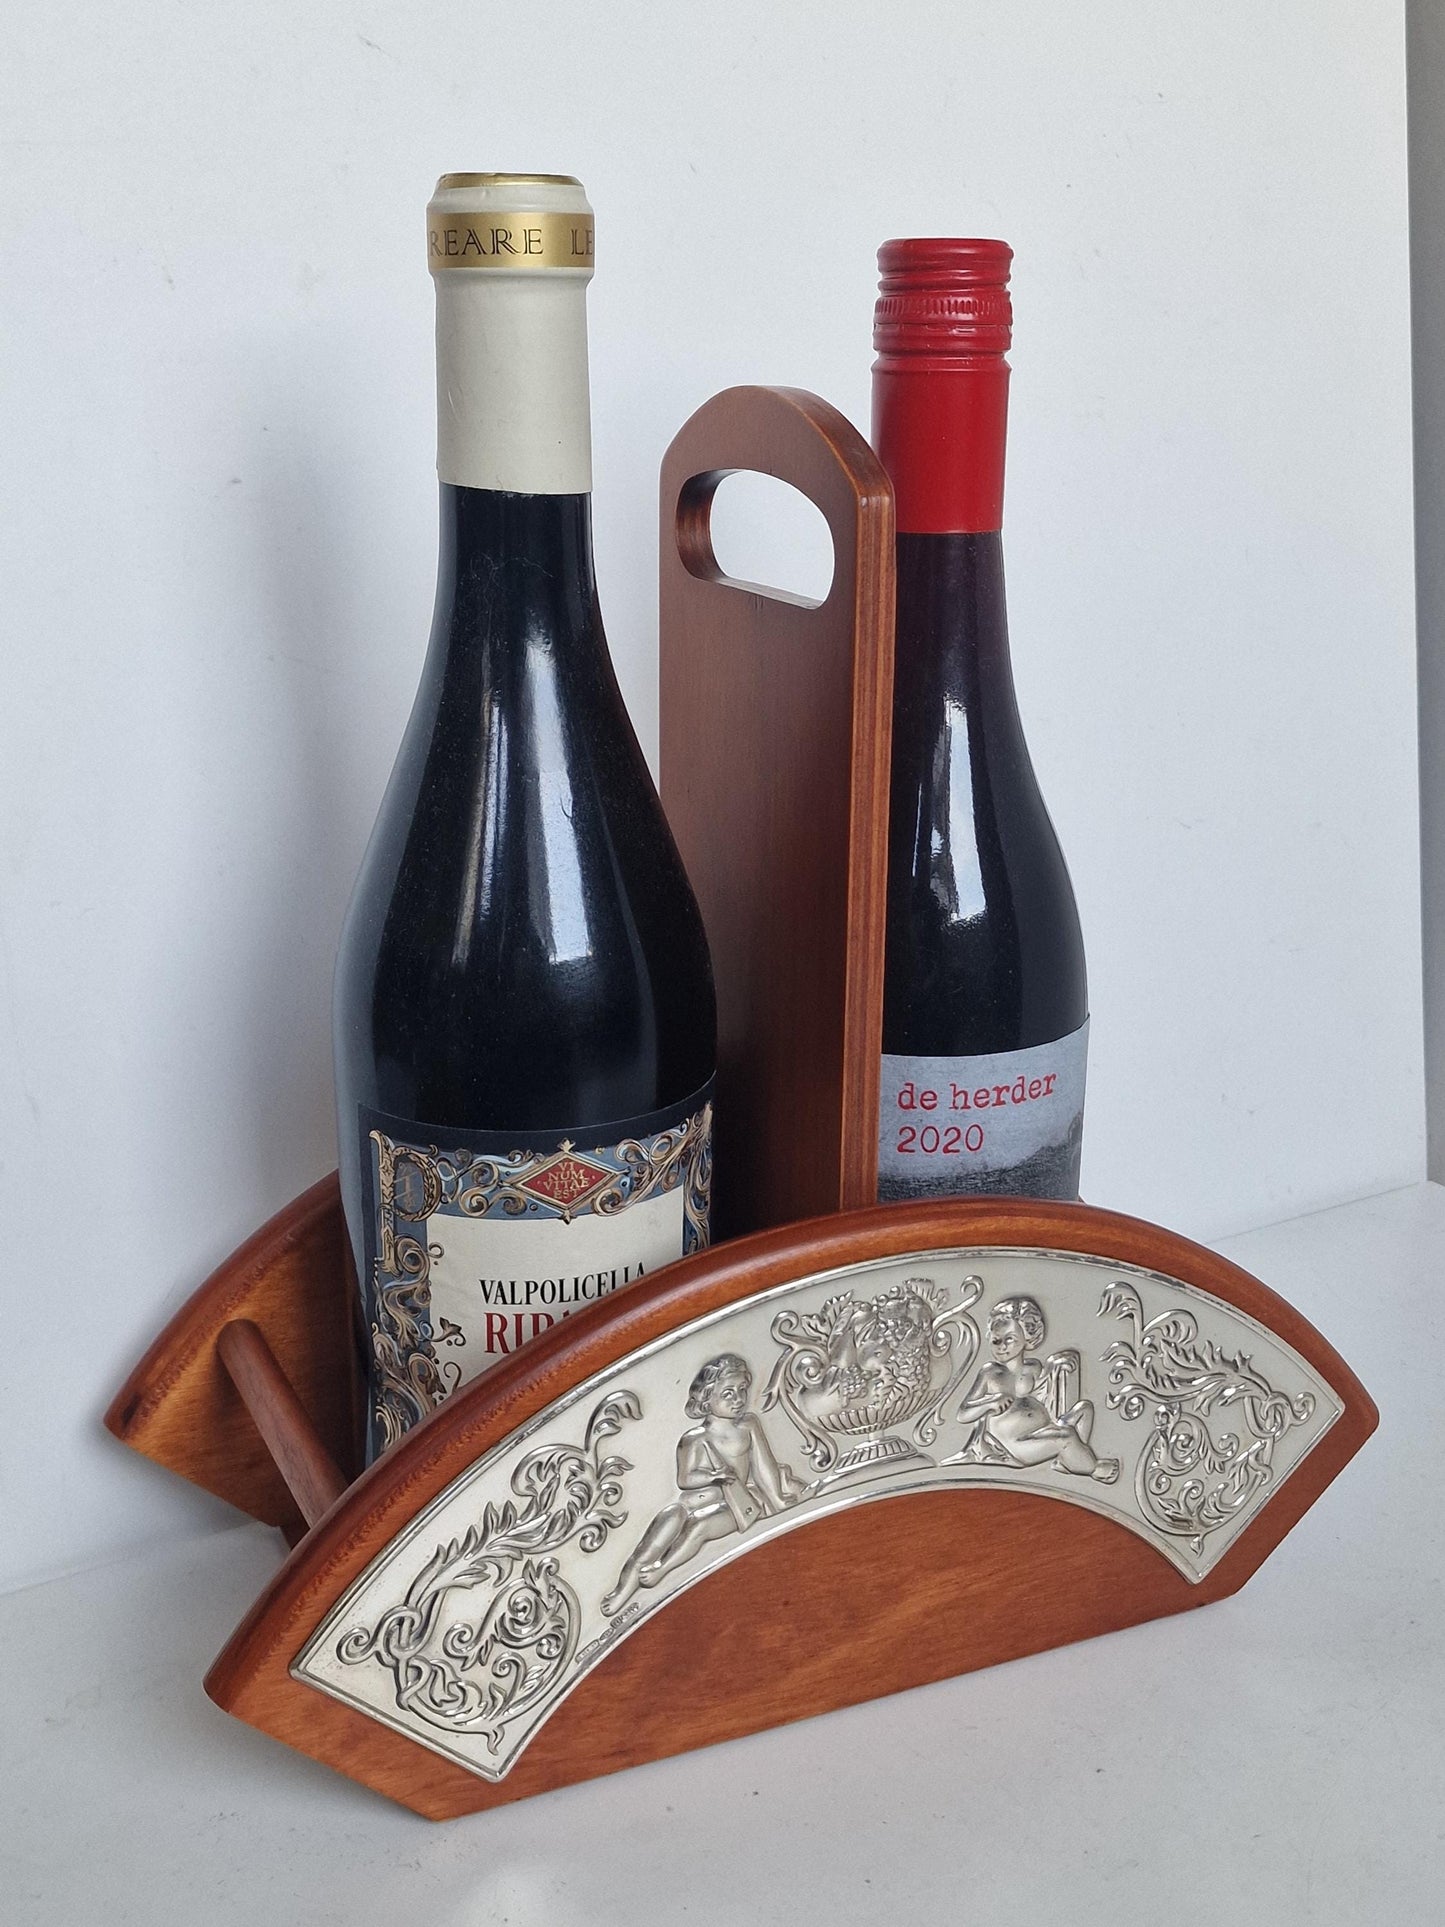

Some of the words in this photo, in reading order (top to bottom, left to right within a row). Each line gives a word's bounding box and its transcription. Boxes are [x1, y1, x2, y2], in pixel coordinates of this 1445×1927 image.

[898, 1083, 938, 1110] de
[949, 1073, 1057, 1110] herder
[897, 1124, 984, 1154] 2020
[558, 1161, 575, 1170] VI
[548, 1169, 585, 1181] NUM
[543, 1178, 590, 1191] VITAE
[554, 1189, 579, 1199] EST
